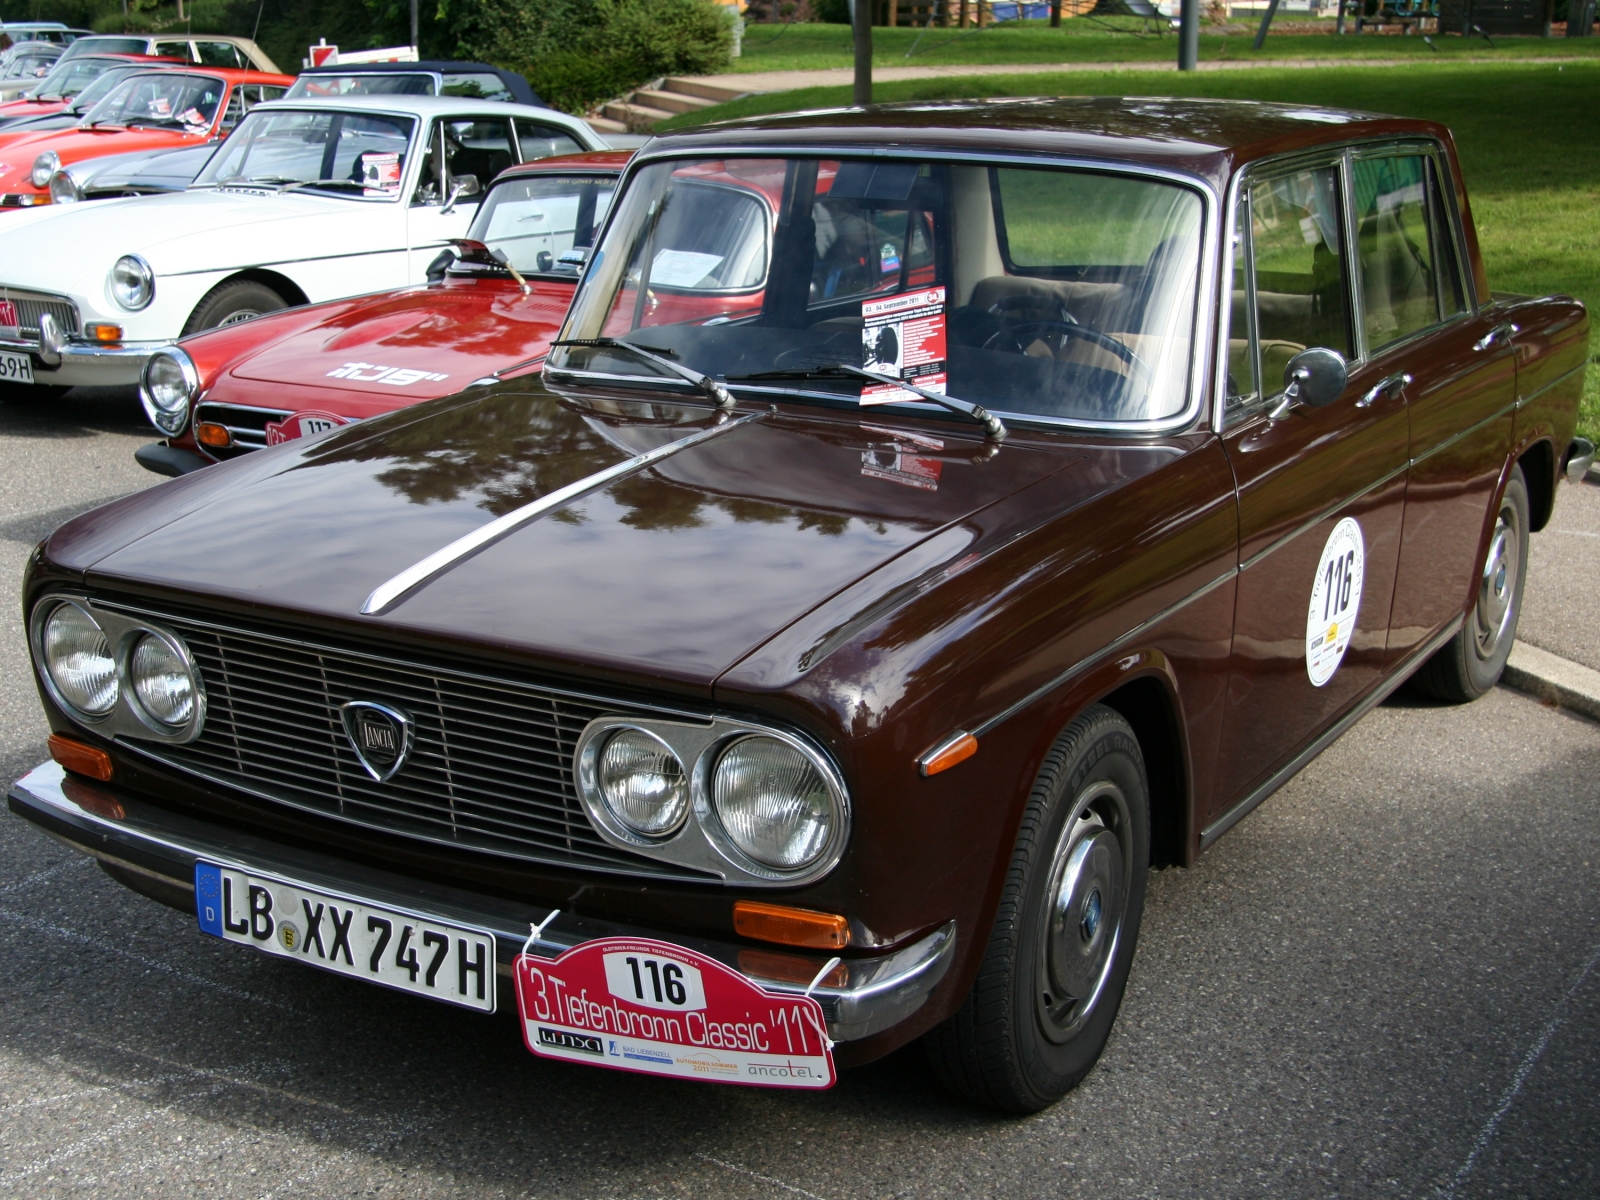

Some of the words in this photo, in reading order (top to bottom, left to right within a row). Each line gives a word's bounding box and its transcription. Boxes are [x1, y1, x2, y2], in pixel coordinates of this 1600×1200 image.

[883, 300, 908, 310] September
[1324, 549, 1355, 622] 116
[364, 722, 394, 749] LANCIA
[1071, 739, 1112, 793] STEEL
[205, 906, 215, 922] D
[223, 877, 275, 941] LB
[302, 898, 355, 967] XX
[651, 948, 689, 963] TIEFENBRONN
[625, 956, 688, 1006] 116
[685, 1011, 770, 1051] Classic
[622, 1045, 636, 1053] BAD
[636, 1047, 672, 1059] LIEBENZELL
[676, 1058, 738, 1069] AUTOMOBILSOMMER
[692, 1064, 710, 1073] 2011
[748, 1060, 815, 1078] ancotel
